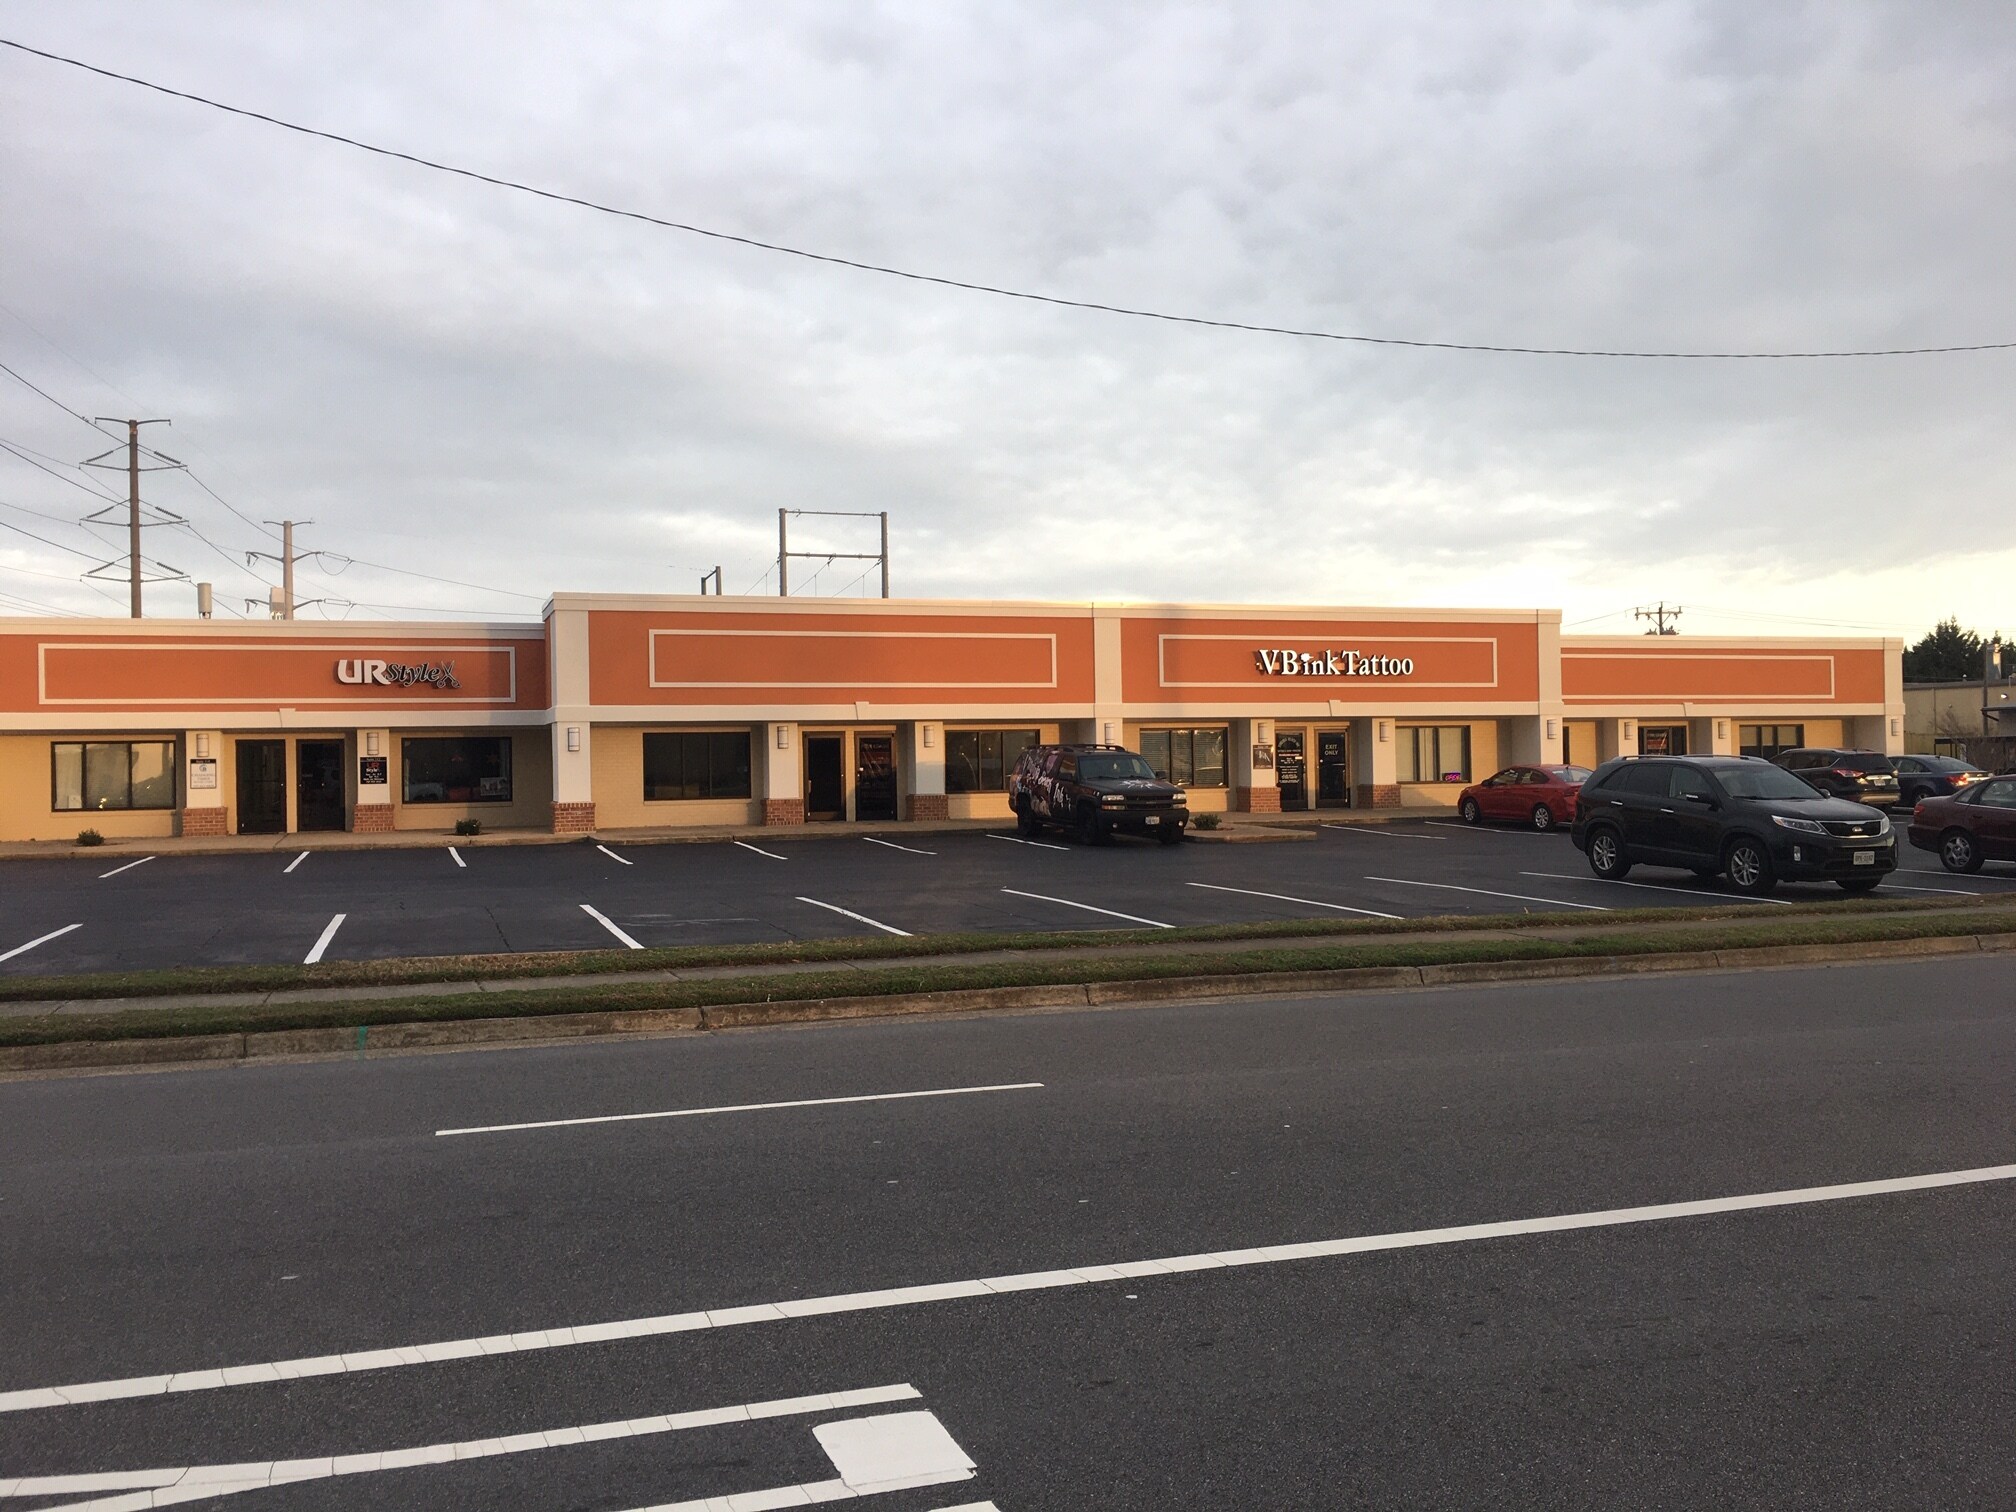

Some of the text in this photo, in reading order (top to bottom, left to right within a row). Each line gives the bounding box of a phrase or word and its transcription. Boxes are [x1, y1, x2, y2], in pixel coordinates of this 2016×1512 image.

[338, 659, 441, 687] UR Style
[1342, 650, 1414, 676] Tattoo
